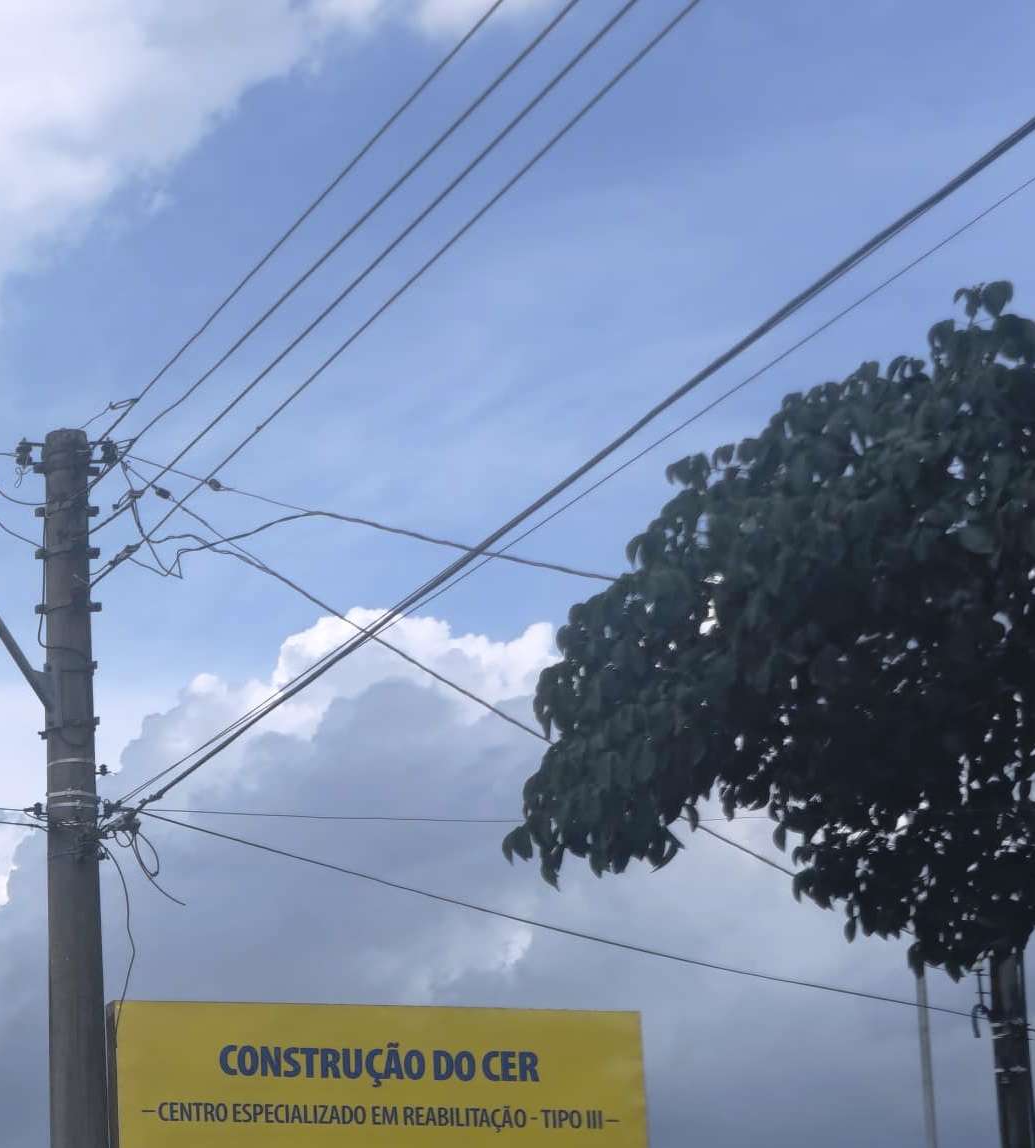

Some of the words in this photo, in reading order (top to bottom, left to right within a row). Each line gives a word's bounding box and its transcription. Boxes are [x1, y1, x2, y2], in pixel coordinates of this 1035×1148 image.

[219, 1042, 425, 1087] CONSTRUÇÃO
[433, 1050, 475, 1081] DO
[482, 1051, 540, 1082] CER
[158, 1102, 227, 1122] CENTRO
[232, 1103, 366, 1125] ESPECIALIZADO
[371, 1106, 398, 1125] EM
[403, 1105, 526, 1133] REABILITAÇÃO
[541, 1109, 582, 1129] TIPO
[586, 1110, 603, 1129] III
